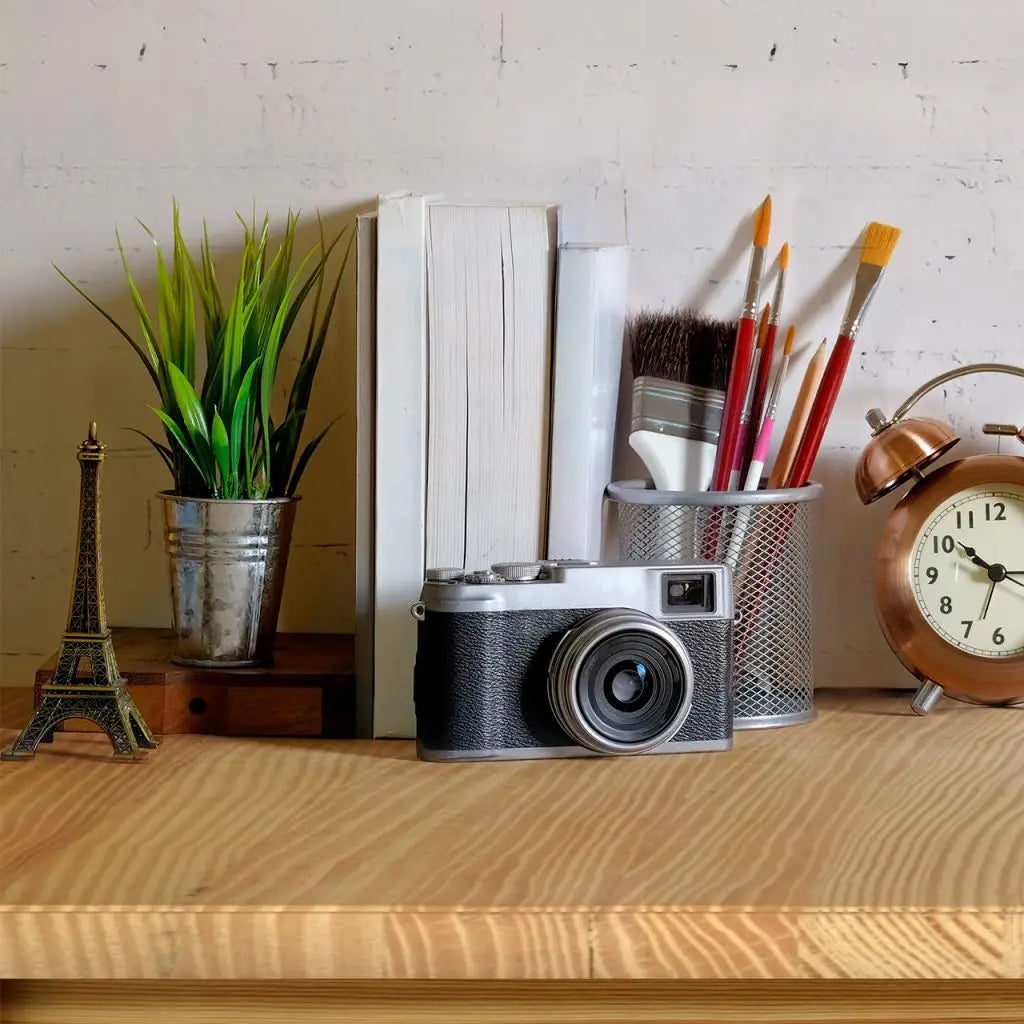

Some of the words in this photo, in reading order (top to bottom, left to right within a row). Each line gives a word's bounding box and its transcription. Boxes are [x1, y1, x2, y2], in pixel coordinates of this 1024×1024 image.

[956, 510, 974, 529] 11
[985, 502, 1007, 521] 12
[933, 534, 955, 554] 10
[925, 566, 939, 585] 9
[939, 595, 953, 615] 8
[960, 620, 974, 639] 7
[992, 627, 1005, 645] 6
